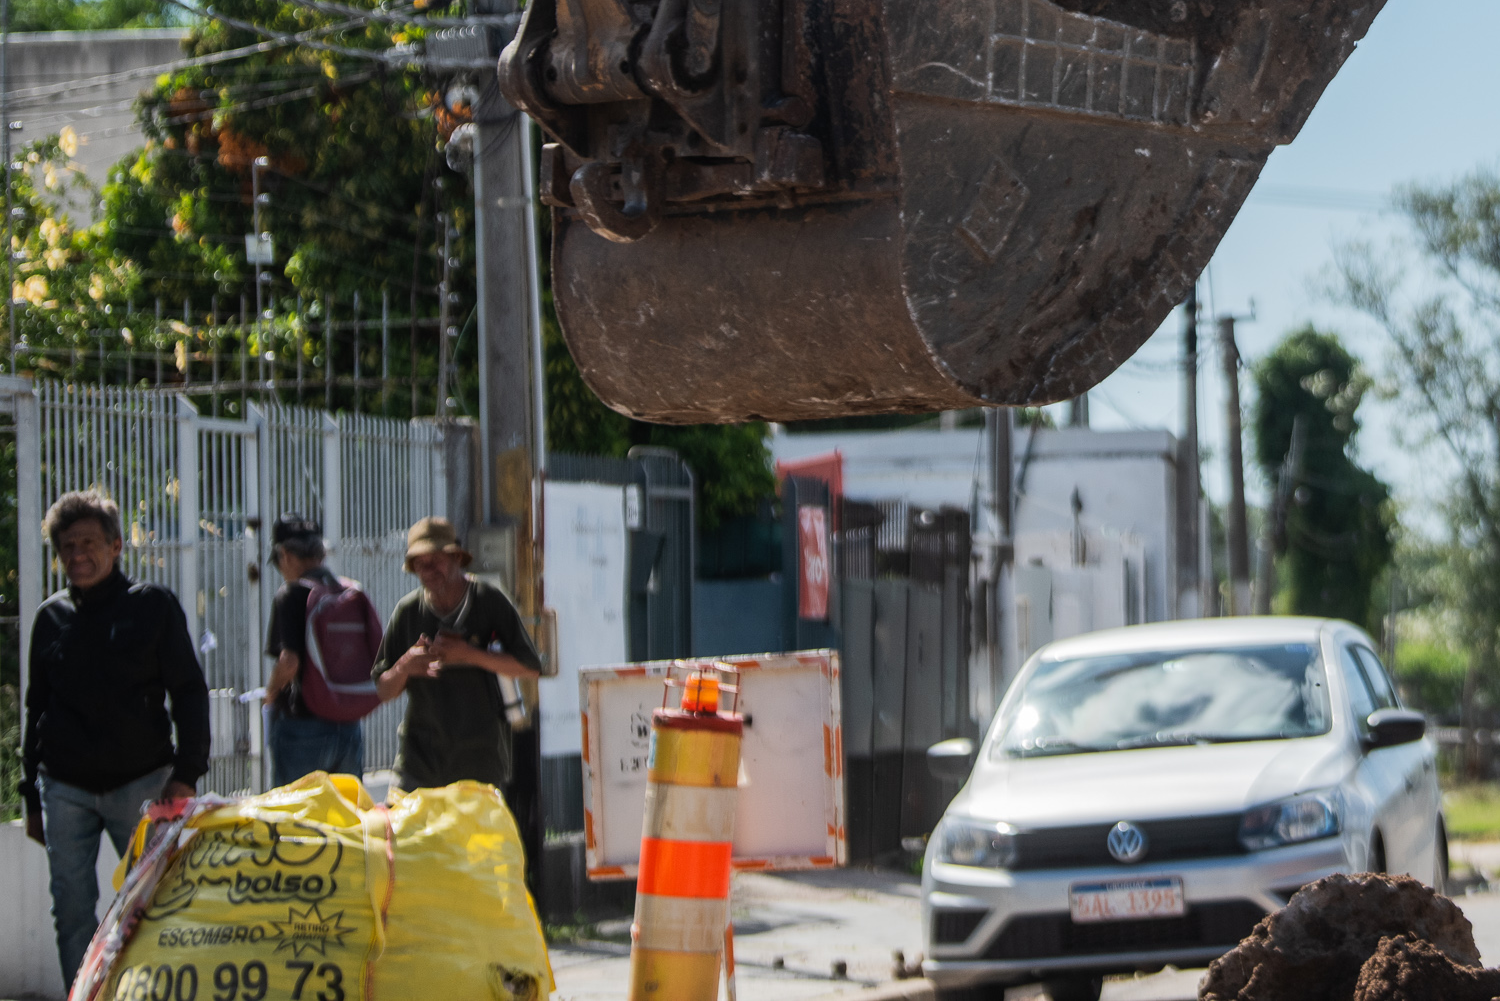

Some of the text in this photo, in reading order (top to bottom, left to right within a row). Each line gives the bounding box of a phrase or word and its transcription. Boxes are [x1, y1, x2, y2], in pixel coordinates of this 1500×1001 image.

[157, 924, 265, 948] ESCOMBRO
[213, 960, 269, 1001] 99
[285, 960, 345, 1001] 73
